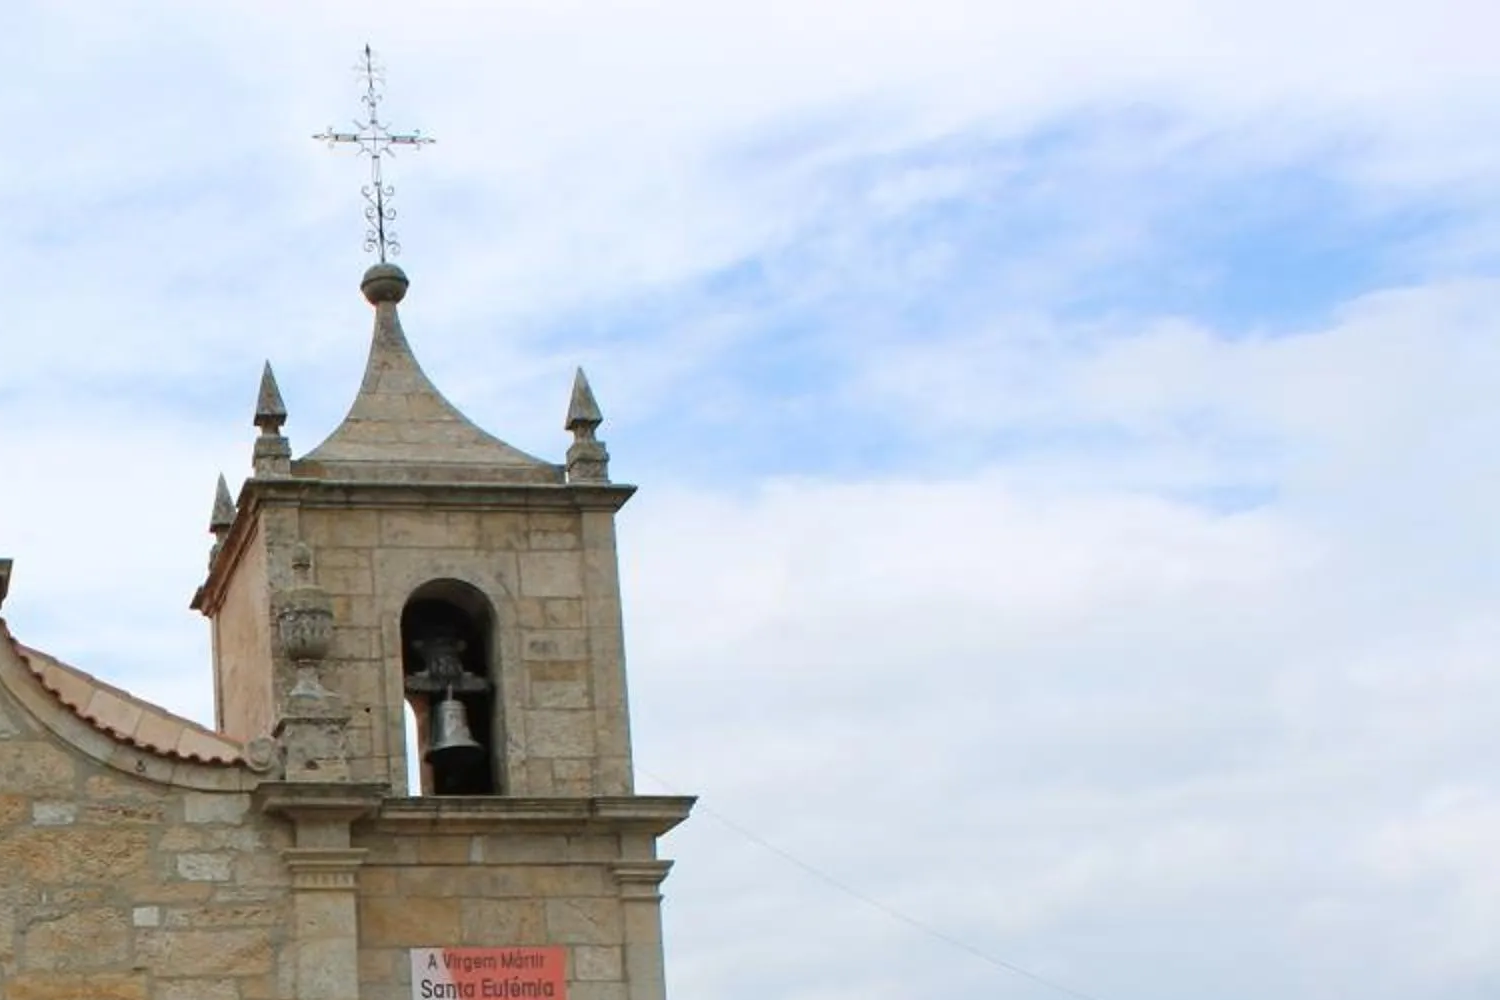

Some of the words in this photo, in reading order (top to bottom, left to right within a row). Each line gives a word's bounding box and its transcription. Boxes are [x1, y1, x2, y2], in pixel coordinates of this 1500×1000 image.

[427, 952, 438, 969] A
[444, 951, 497, 972] Virgem
[420, 979, 476, 999] Santa
[481, 976, 555, 999] Eufémia
